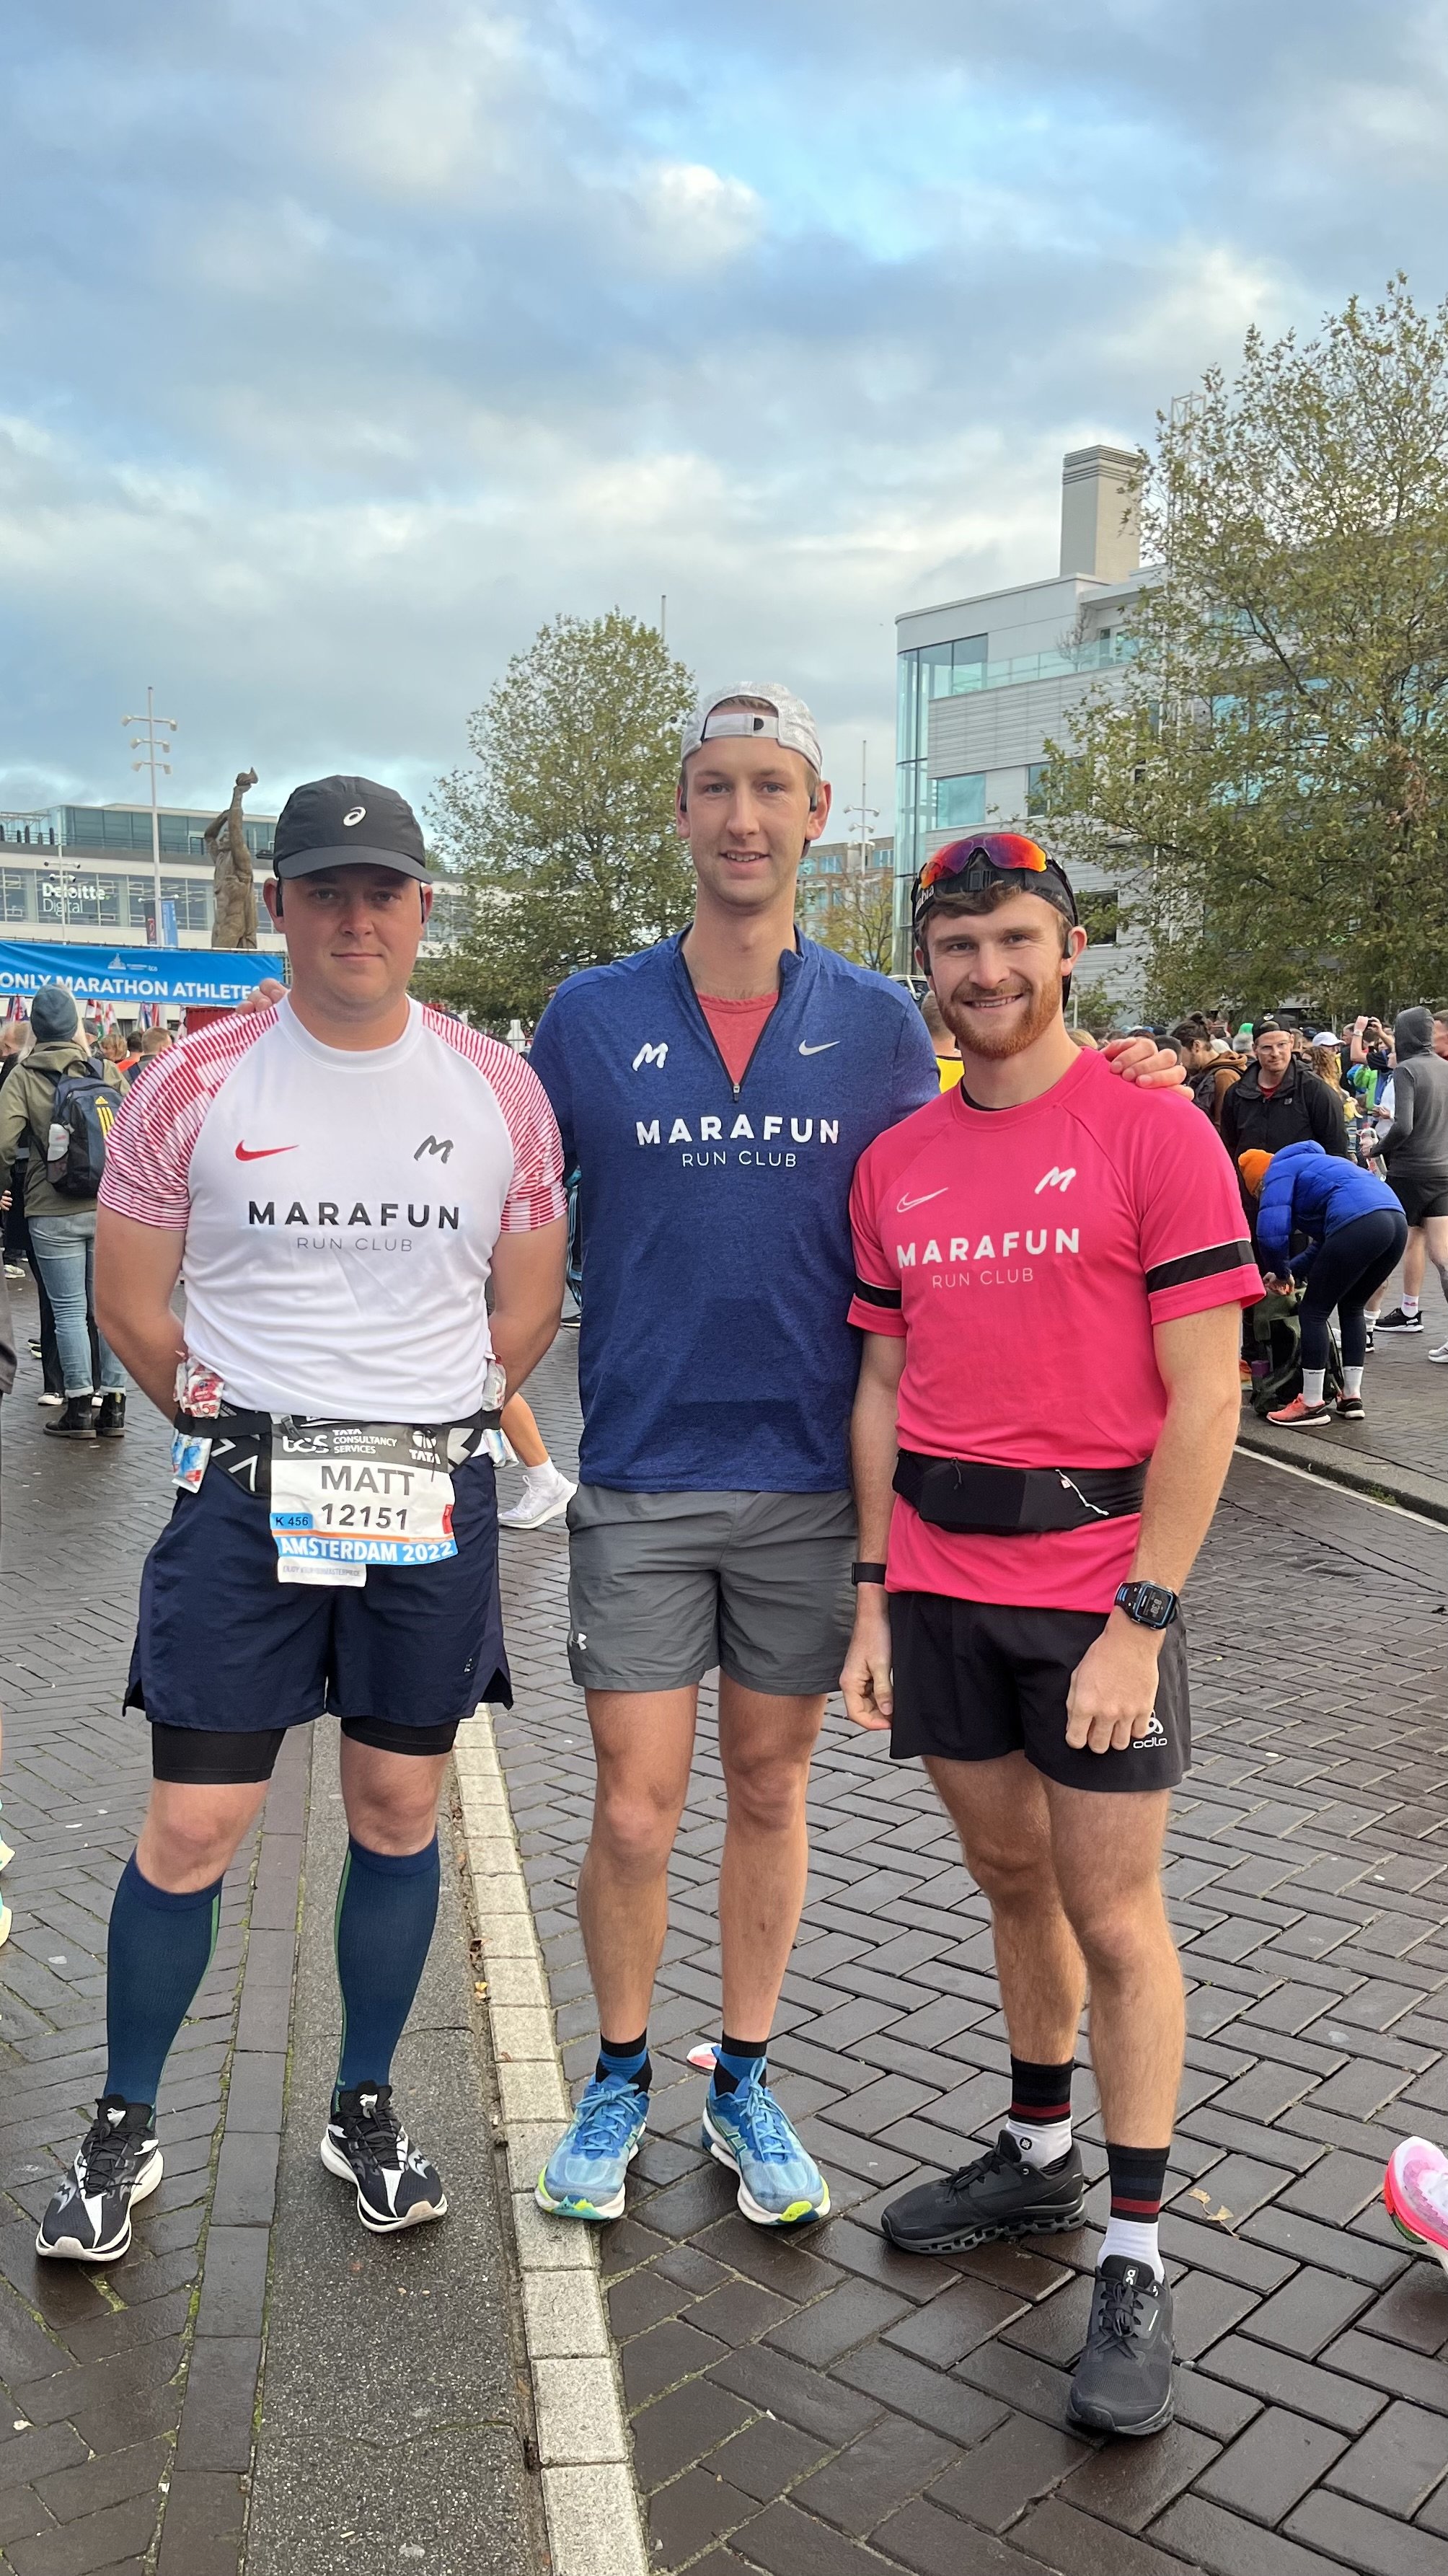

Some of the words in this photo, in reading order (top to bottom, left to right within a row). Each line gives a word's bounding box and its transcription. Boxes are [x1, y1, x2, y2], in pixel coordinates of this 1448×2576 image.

[43, 898, 83, 917] Digital
[0, 971, 52, 990] ONLY
[56, 976, 168, 996] MARATHON
[172, 982, 260, 1000] ATHLETE
[635, 1113, 839, 1146] MARAFUN
[682, 1151, 726, 1167] RUN
[738, 1150, 797, 1167] CLUB
[248, 1201, 459, 1230] MARAFUN
[296, 1237, 343, 1250] RUN
[355, 1238, 412, 1252] CLUB
[896, 1227, 1080, 1269] MARAFUN
[932, 1272, 970, 1289] RUN
[980, 1267, 1033, 1285] CLUB
[332, 1434, 398, 1447] CONSULTANCY
[333, 1444, 376, 1455] SERVICES
[409, 1448, 441, 1465] TATA
[321, 1465, 415, 1496] MATT
[275, 1517, 283, 1526] K
[288, 1517, 309, 1526] 456
[321, 1503, 407, 1530] 12151
[281, 1537, 397, 1562] AMSTERDAM
[402, 1541, 454, 1562] 2022
[1133, 1737, 1167, 1749] odlo
